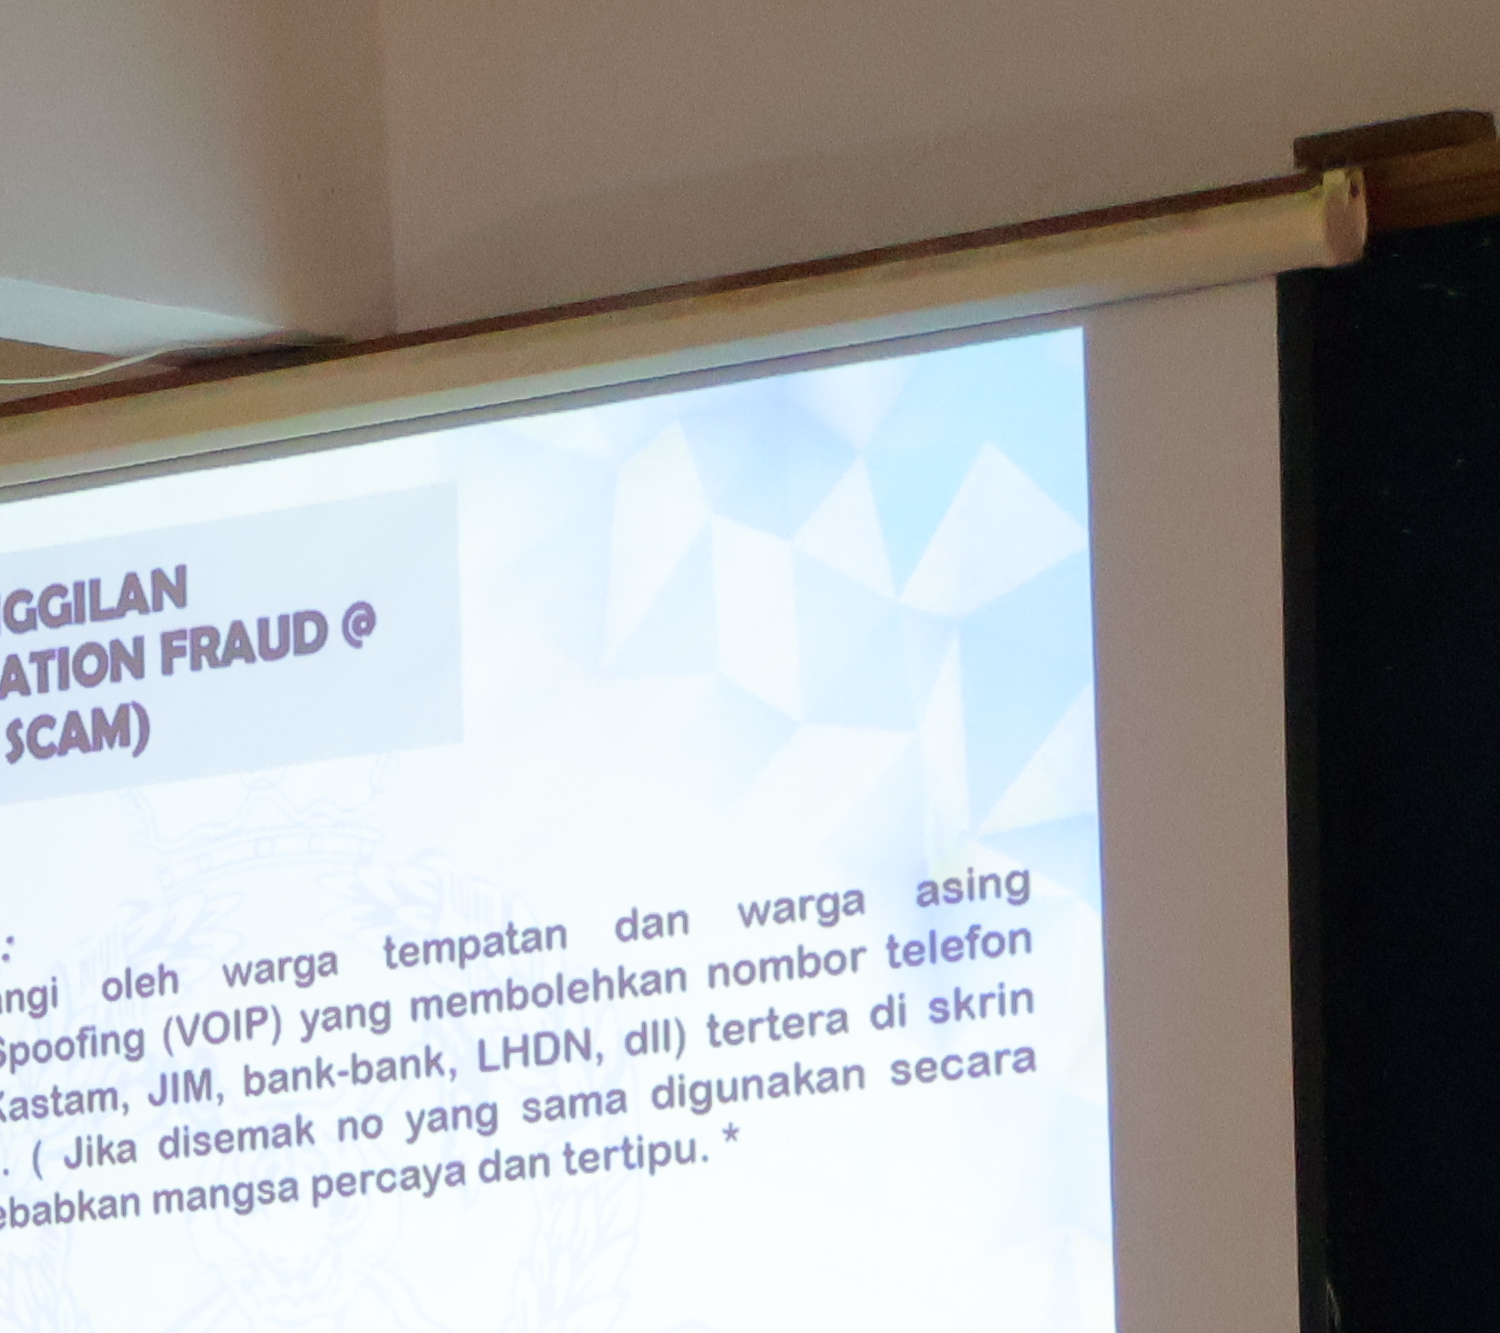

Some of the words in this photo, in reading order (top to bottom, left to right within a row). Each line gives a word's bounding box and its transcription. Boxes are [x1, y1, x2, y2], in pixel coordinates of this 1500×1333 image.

[159, 608, 330, 677] FRAUD
[340, 600, 377, 650] @
[4, 699, 152, 766] SCAM)
[101, 962, 180, 1003] oleh
[221, 950, 339, 990] warga
[382, 920, 568, 971] tempatan
[614, 906, 690, 944] dan
[736, 888, 866, 929] warga
[915, 866, 1031, 909] asing
[162, 1004, 283, 1058] (VOIP)
[299, 999, 392, 1044] yang
[410, 964, 688, 1023] membolehkan
[707, 943, 868, 989] nombor
[885, 923, 1033, 970] telefon
[147, 1067, 225, 1108] JIM,
[243, 1044, 458, 1098] bank-bank,
[477, 1026, 604, 1074] LHDN,
[624, 1017, 686, 1060] dll)
[705, 1006, 849, 1049] tertera
[869, 992, 907, 1031] di
[928, 981, 1034, 1025] skrin
[62, 1133, 138, 1171] Jika
[157, 1113, 316, 1161] disemak
[337, 1113, 384, 1143] no
[405, 1101, 499, 1145] yang
[522, 1088, 628, 1125] sama
[650, 1061, 866, 1116] digunakan
[890, 1045, 1037, 1087] secara
[152, 1176, 300, 1217] mangsa
[311, 1160, 467, 1209] percaya
[477, 1148, 551, 1185] dan
[561, 1134, 709, 1177] tertipu.
